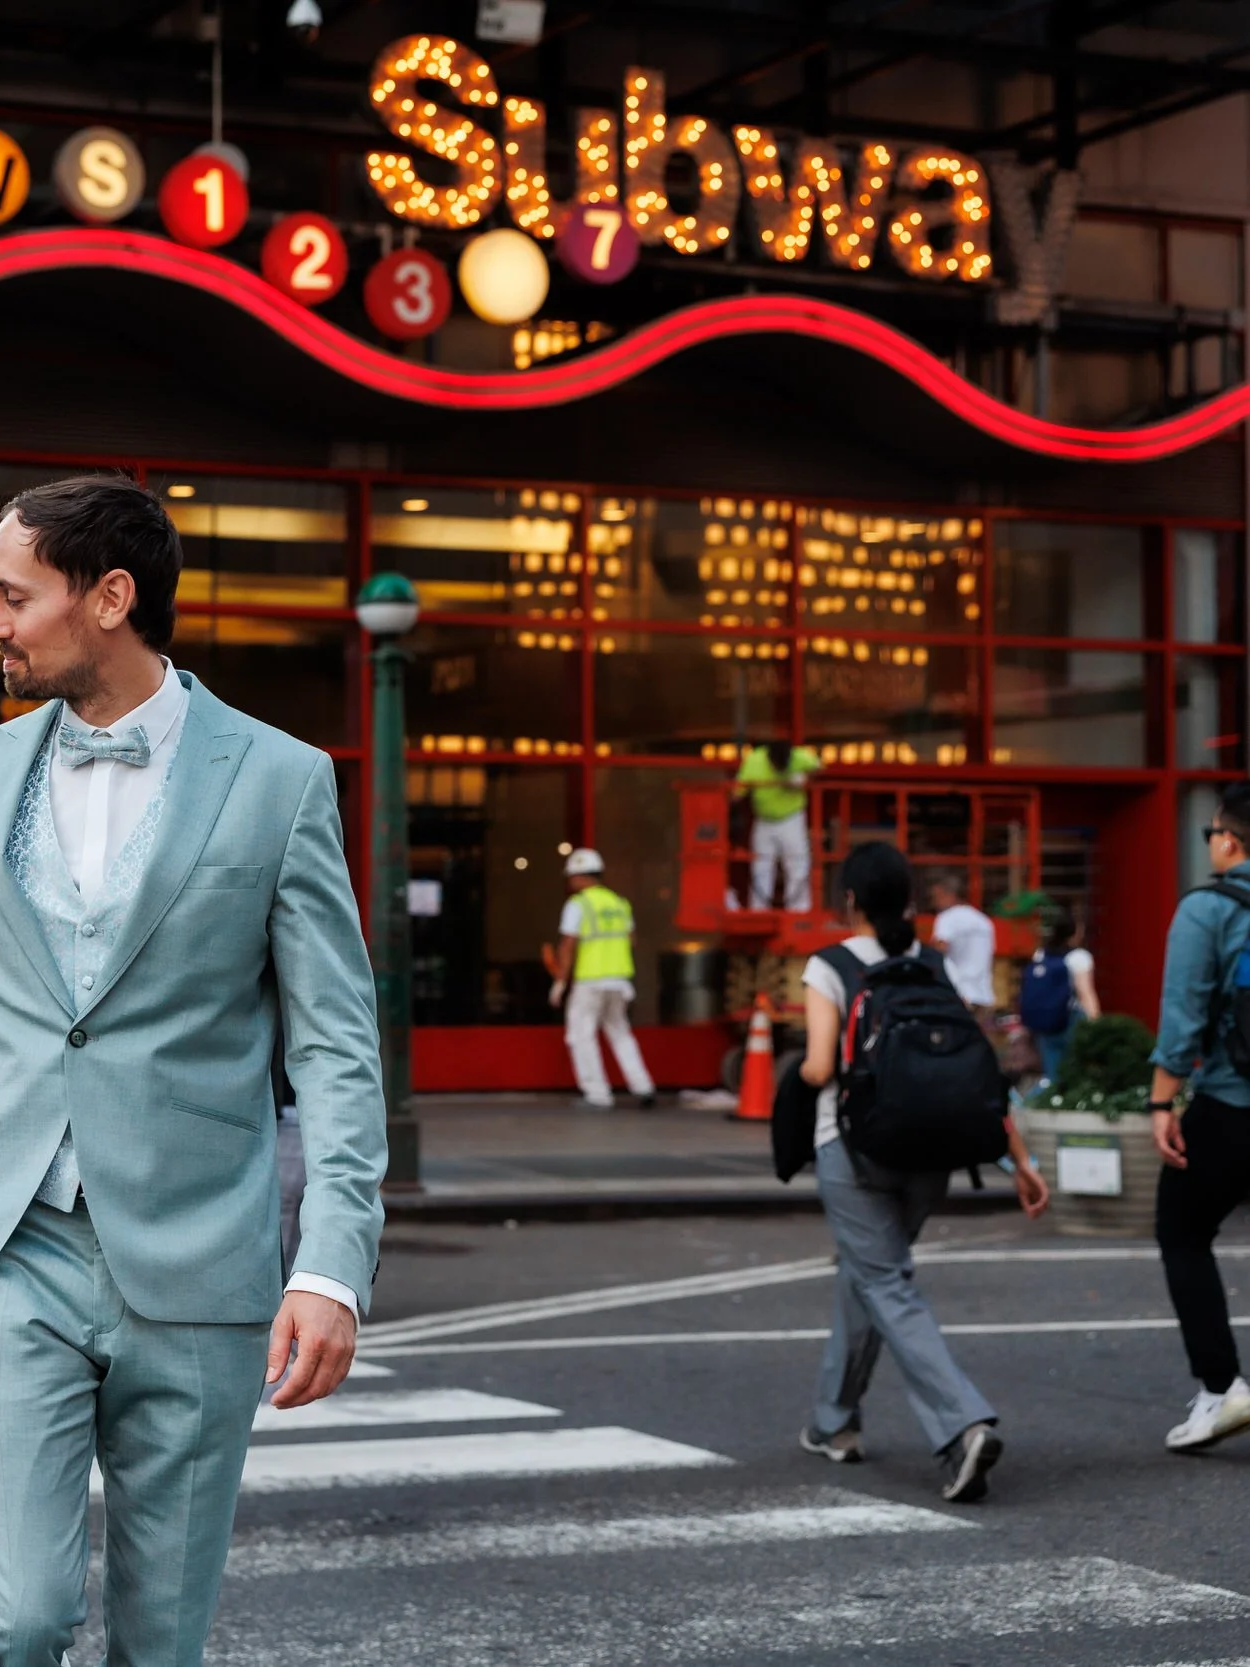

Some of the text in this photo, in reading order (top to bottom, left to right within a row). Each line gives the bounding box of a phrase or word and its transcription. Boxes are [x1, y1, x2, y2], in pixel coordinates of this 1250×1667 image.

[77, 139, 129, 208] S
[195, 169, 225, 233] 1
[289, 225, 333, 290] 2
[392, 262, 435, 325] 3
[582, 210, 623, 270] 7
[366, 33, 1083, 325] Subway
